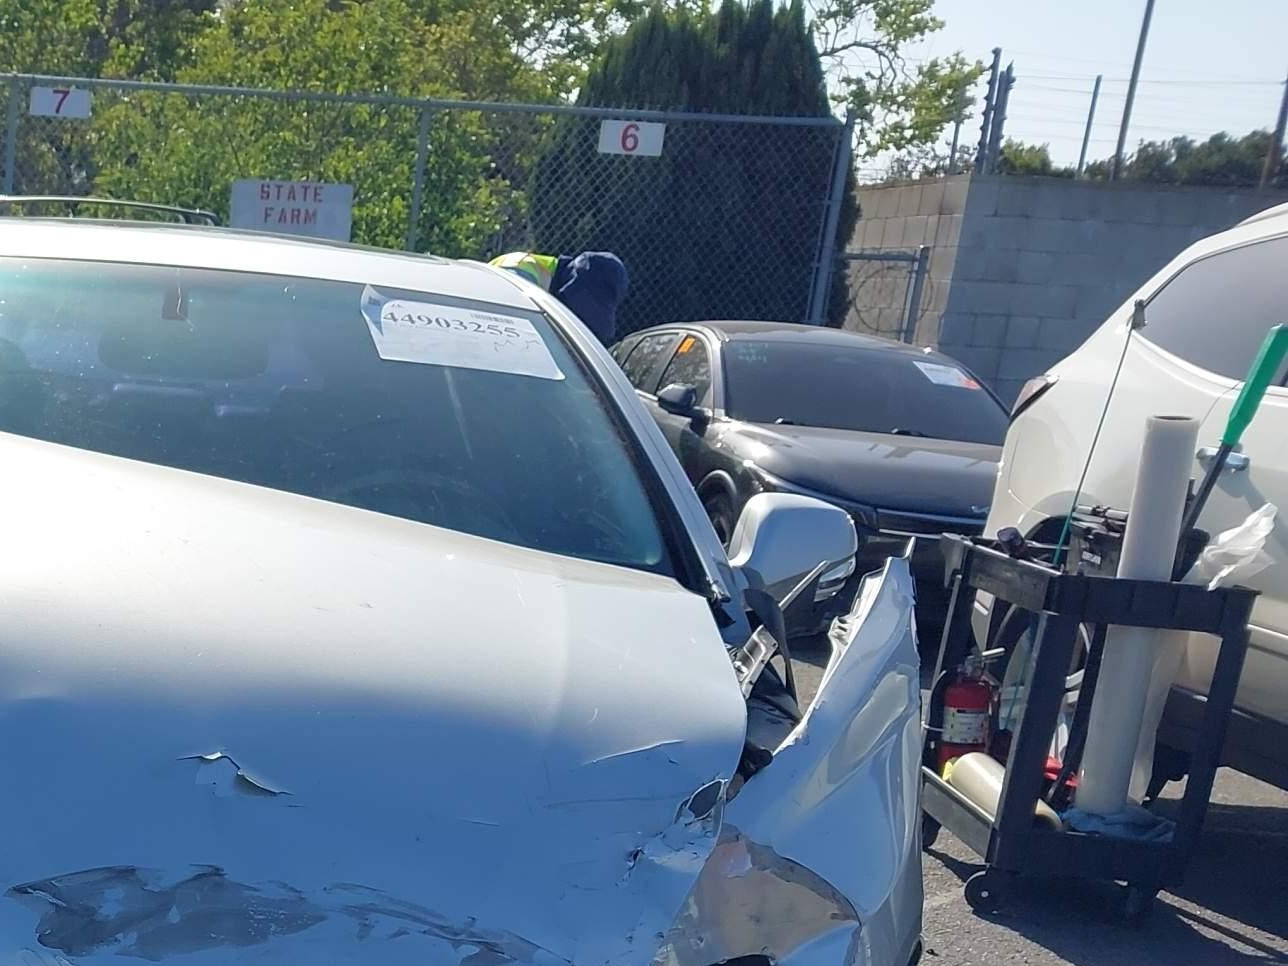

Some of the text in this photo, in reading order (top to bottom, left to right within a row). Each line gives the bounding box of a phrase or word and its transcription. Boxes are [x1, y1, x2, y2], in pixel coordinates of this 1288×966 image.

[53, 89, 70, 114] 7
[621, 123, 640, 152] 6
[260, 183, 324, 203] STATE
[264, 207, 317, 225] FARM
[383, 311, 521, 339] 44903255
